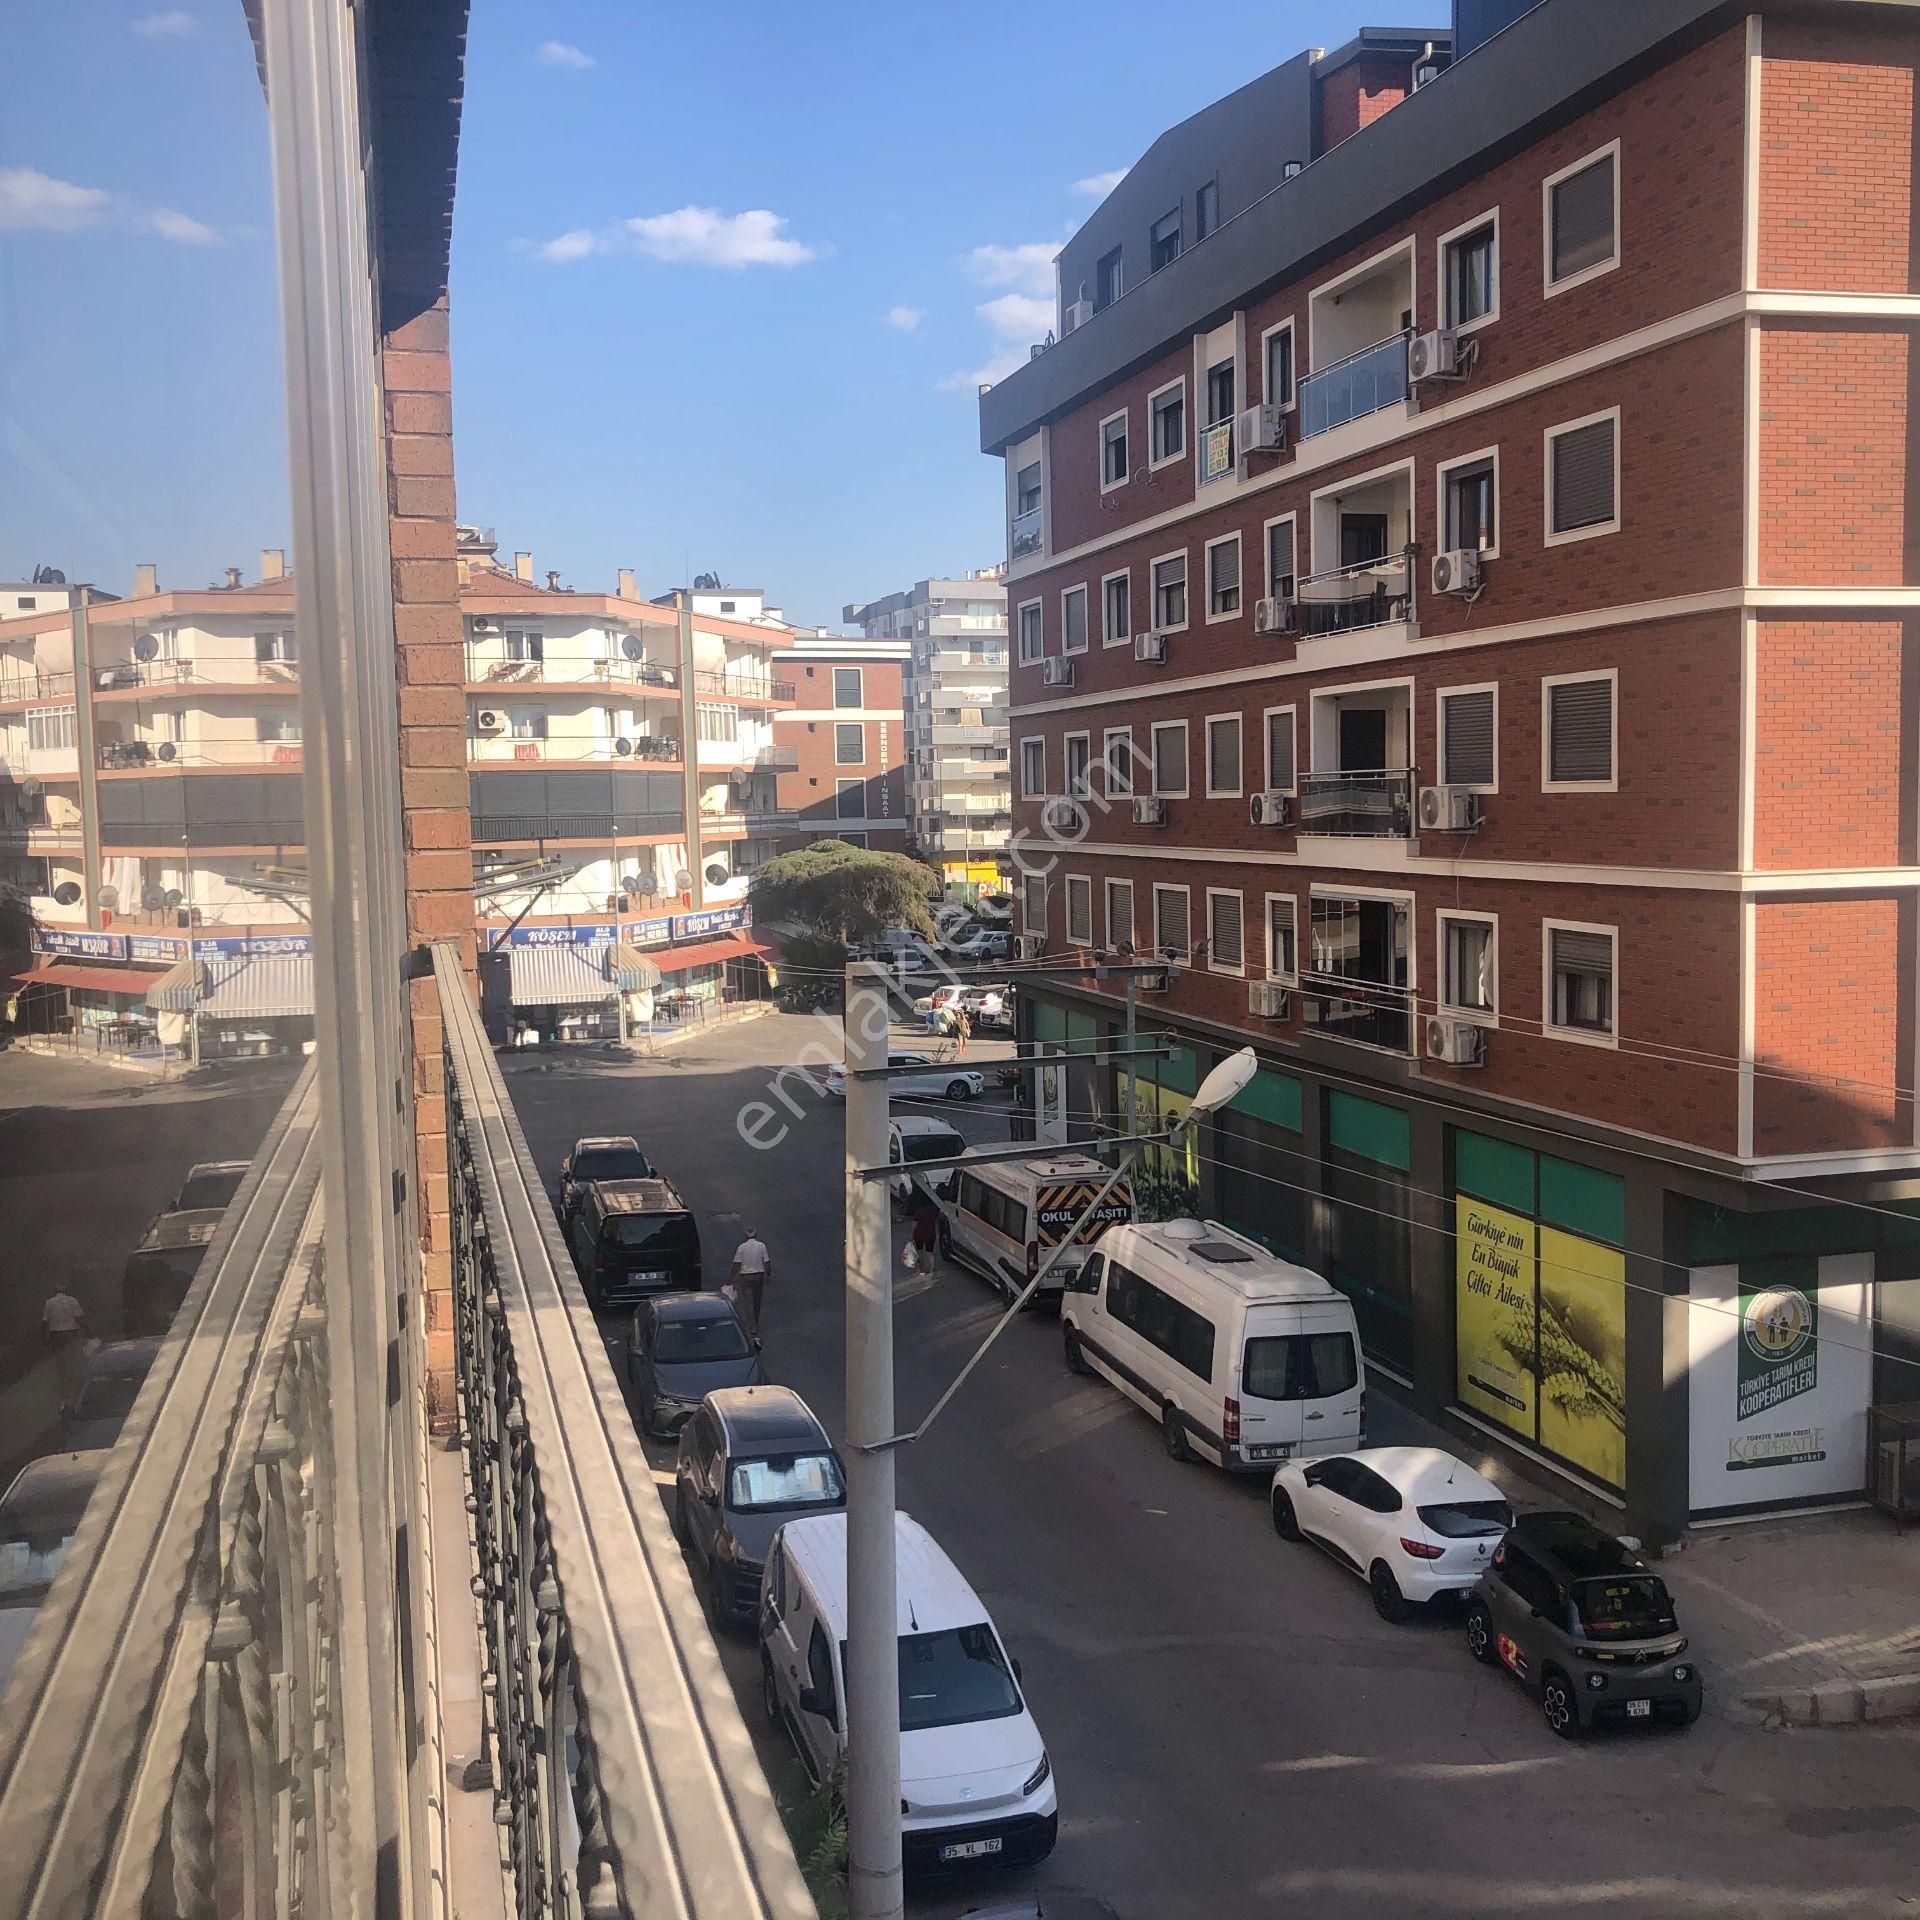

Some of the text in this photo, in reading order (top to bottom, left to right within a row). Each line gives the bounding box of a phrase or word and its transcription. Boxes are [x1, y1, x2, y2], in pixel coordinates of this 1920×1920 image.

[527, 928, 577, 944] KÖŞEM
[1041, 1211, 1075, 1223] OKUL
[1090, 1207, 1127, 1222] TAŞITI
[1472, 1242, 1521, 1281] En Büyük
[1467, 1270, 1525, 1310] Çiftçi Ailesi
[1740, 1351, 1816, 1397] TÜRKİYE TARIM KREDİ
[1740, 1367, 1816, 1417] KOOPERATİFLERİ
[1791, 1451, 1821, 1463] market
[946, 1846, 958, 1857] 35
[984, 1840, 1000, 1852] 162
